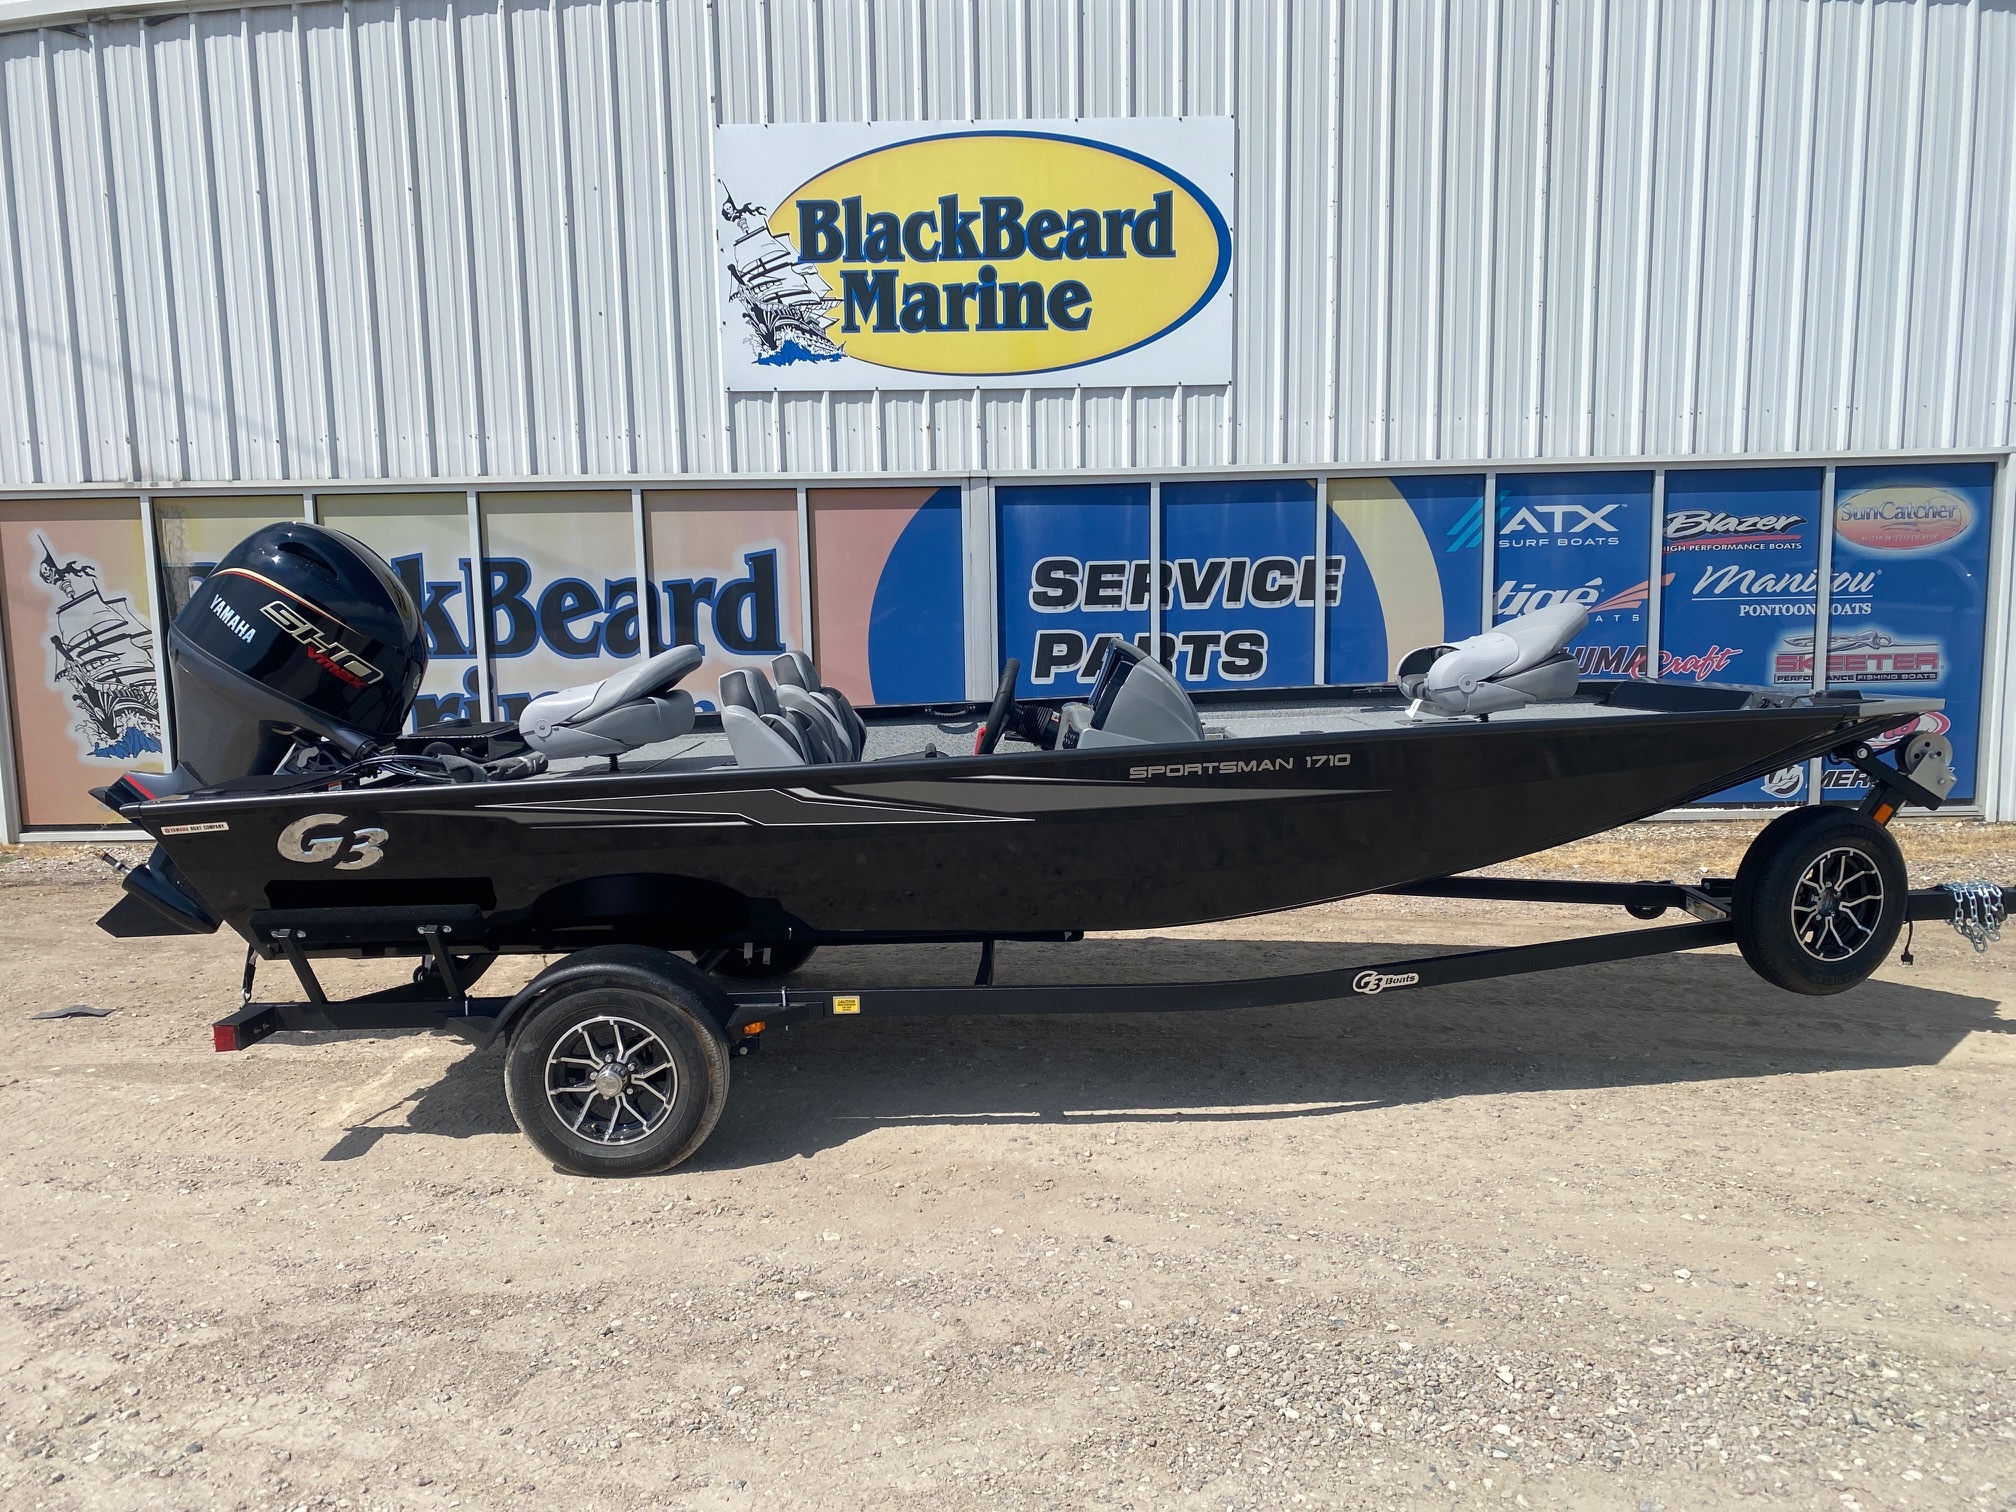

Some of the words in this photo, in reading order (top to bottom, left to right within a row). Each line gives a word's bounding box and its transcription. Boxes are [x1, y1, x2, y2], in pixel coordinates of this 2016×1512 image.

[795, 190, 1176, 263] BlackBeard
[841, 265, 1092, 333] Marine
[1499, 504, 1620, 535] ATX
[1665, 509, 1806, 539] Blazer
[1841, 500, 1958, 521] SunCatcher
[1498, 538, 1550, 548] SURF
[1557, 537, 1620, 547] BOATS
[1689, 543, 1766, 551] PERFORMANCE
[1769, 542, 1802, 550] BOATS
[1029, 555, 1346, 613] SERVICE
[1692, 564, 1875, 595] Maniou
[209, 593, 257, 645] YAMAHA
[1829, 602, 1872, 615] OATS
[259, 600, 384, 685] SHO
[1775, 653, 1939, 672] SKEETER
[1776, 674, 1854, 682] PERFOANCE
[1857, 673, 1898, 681] FISHING
[1129, 757, 1294, 779] SPORTSMAN
[1306, 753, 1351, 769] 1710
[277, 813, 389, 871] G3
[1355, 973, 1383, 991] G3
[1385, 975, 1416, 985] Boats
